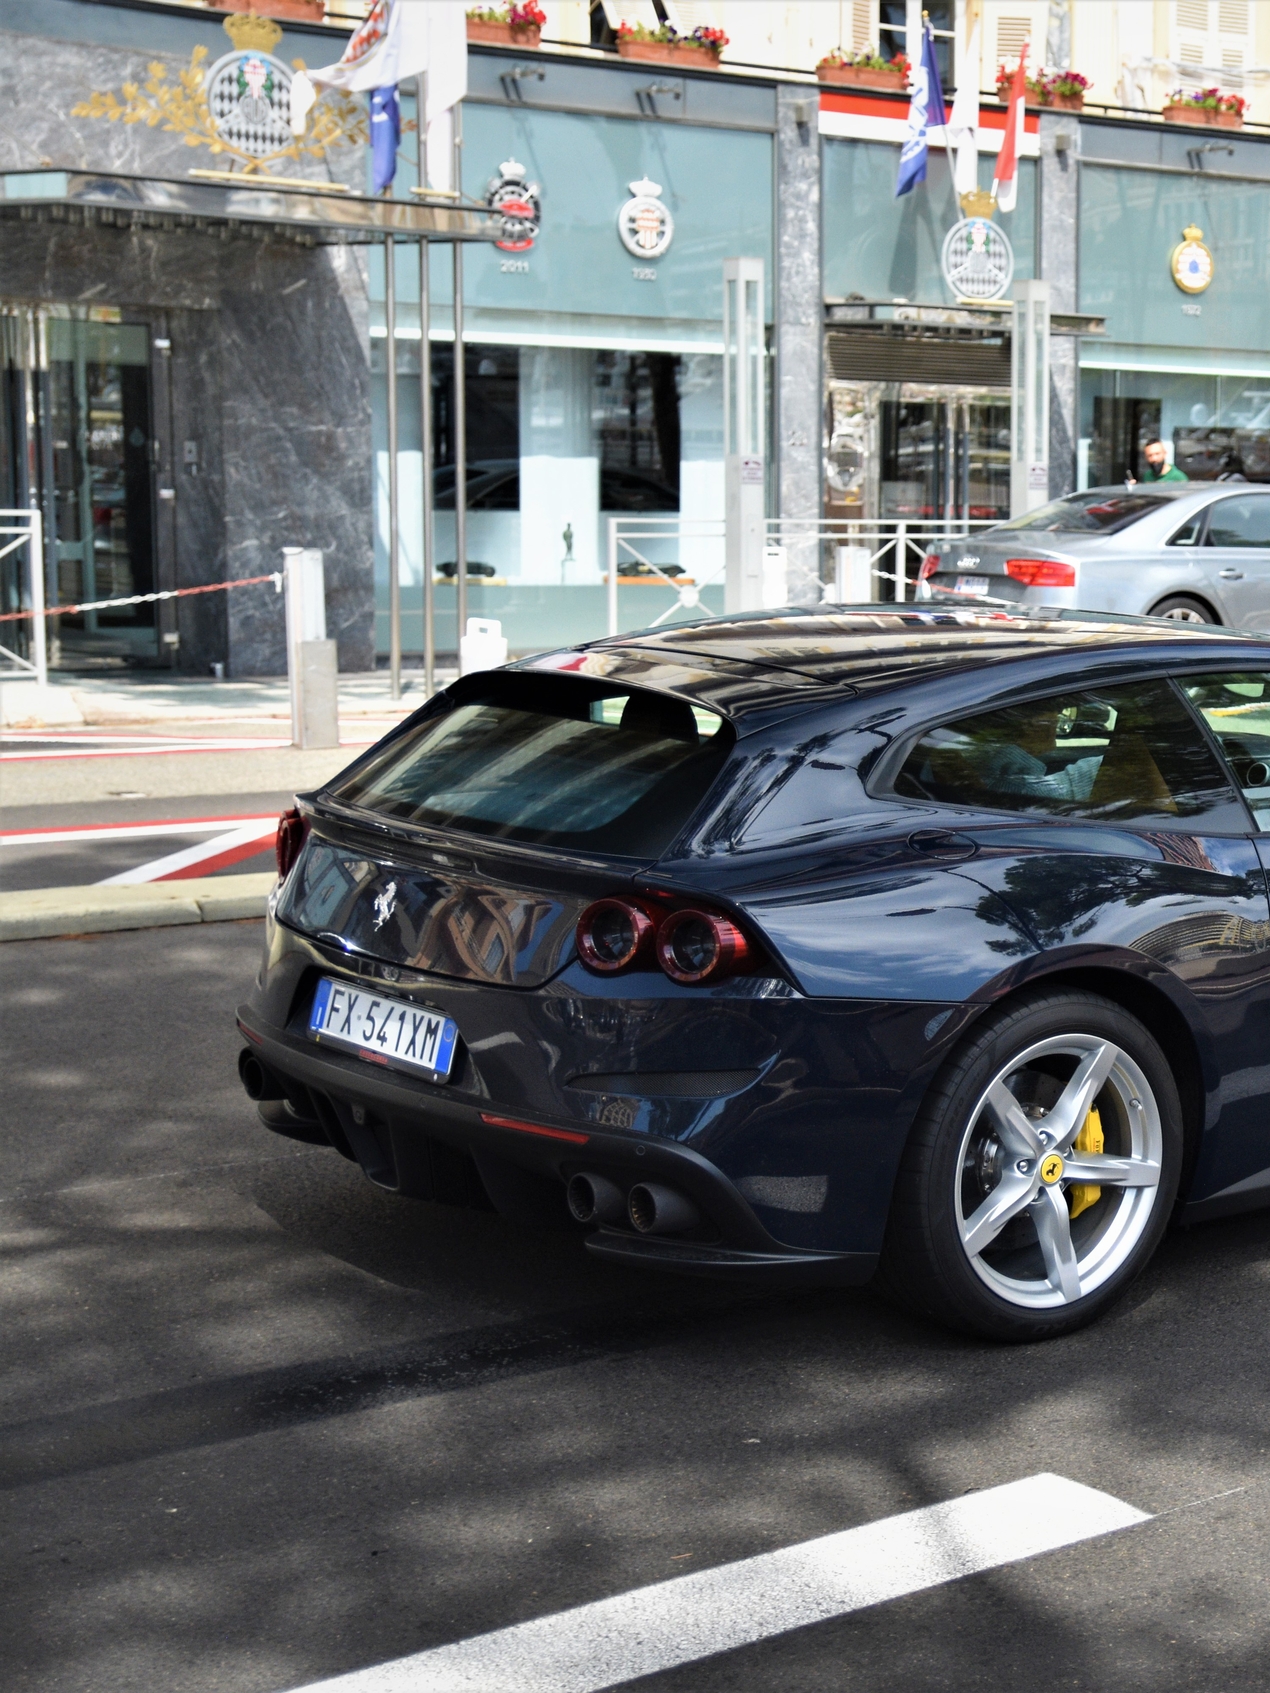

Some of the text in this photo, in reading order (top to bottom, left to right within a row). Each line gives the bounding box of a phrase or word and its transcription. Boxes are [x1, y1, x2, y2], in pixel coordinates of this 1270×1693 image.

[500, 259, 529, 273] 2011
[326, 988, 441, 1063] FX 541XM
